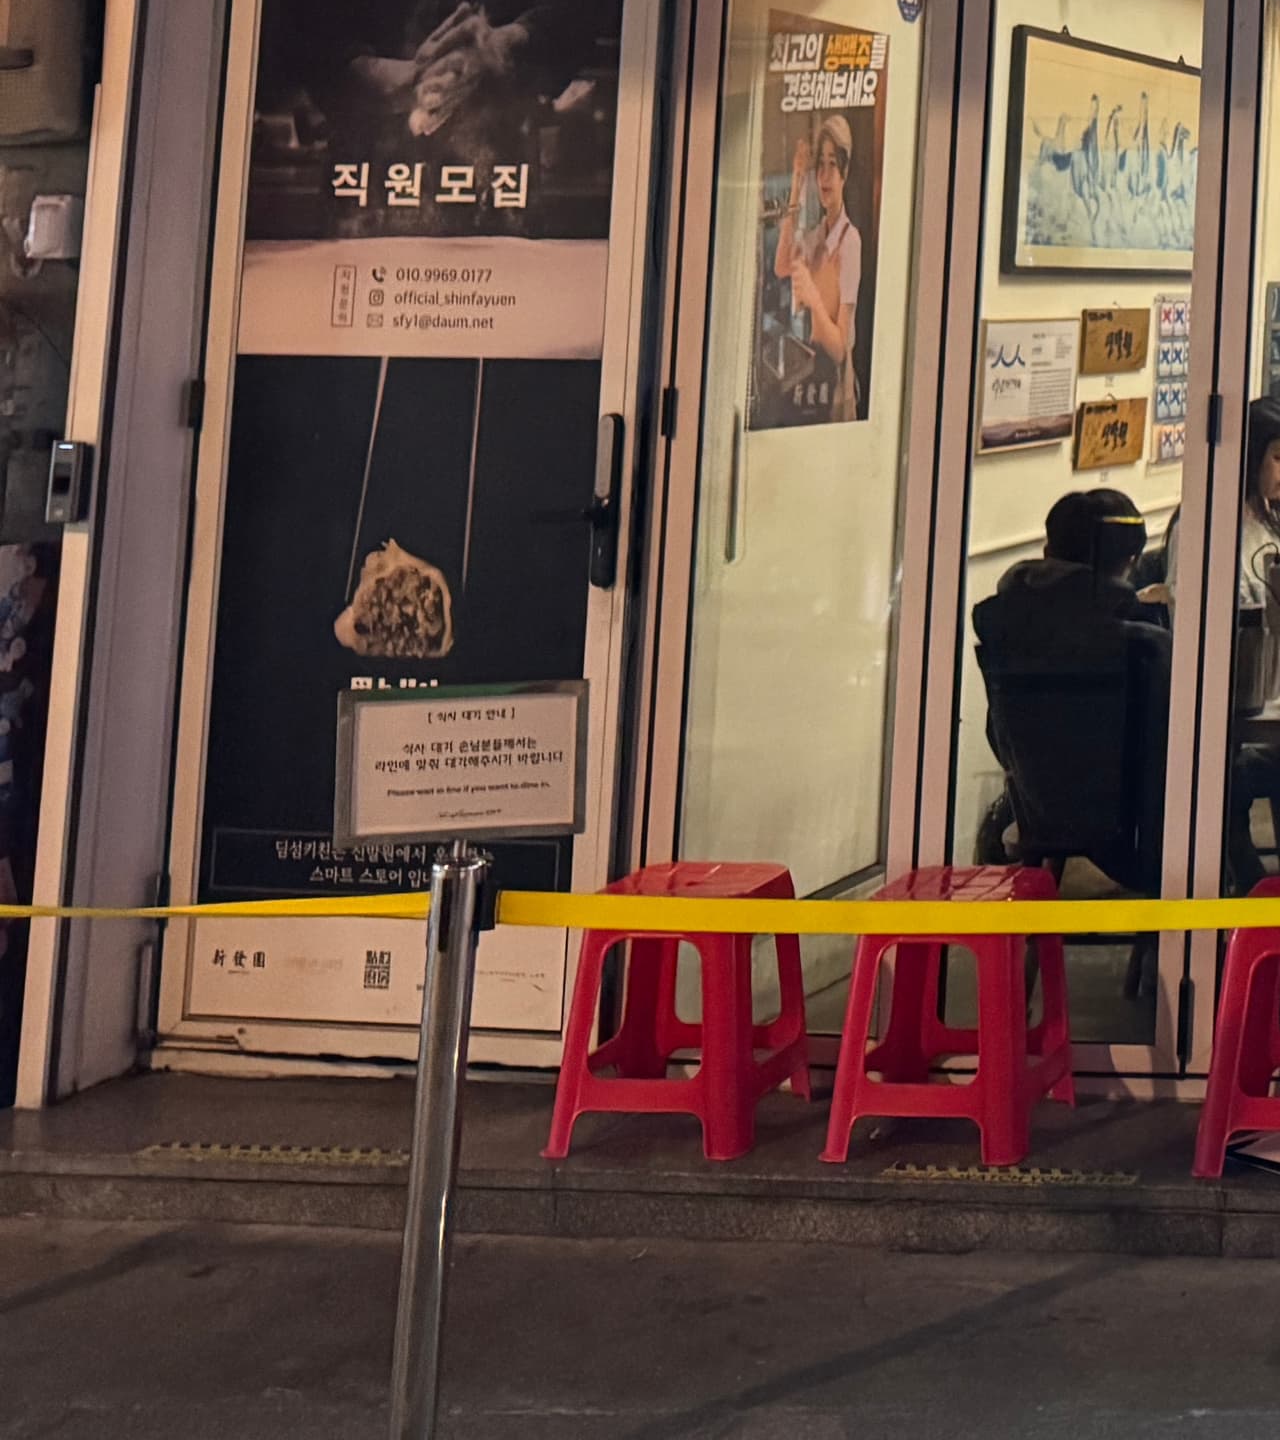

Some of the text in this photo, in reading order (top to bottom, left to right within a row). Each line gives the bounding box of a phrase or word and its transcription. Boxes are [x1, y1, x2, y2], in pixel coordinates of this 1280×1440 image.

[769, 32, 889, 71] 최고의 생맥주를
[781, 70, 878, 112] 경험해보세요
[331, 161, 530, 209] 직원모집
[395, 268, 493, 283] 010.9969.0177
[394, 289, 516, 308] official_shinfayuen
[351, 842, 427, 865] 신발원에서
[309, 866, 354, 884] 스마트
[359, 868, 403, 886] 스토어
